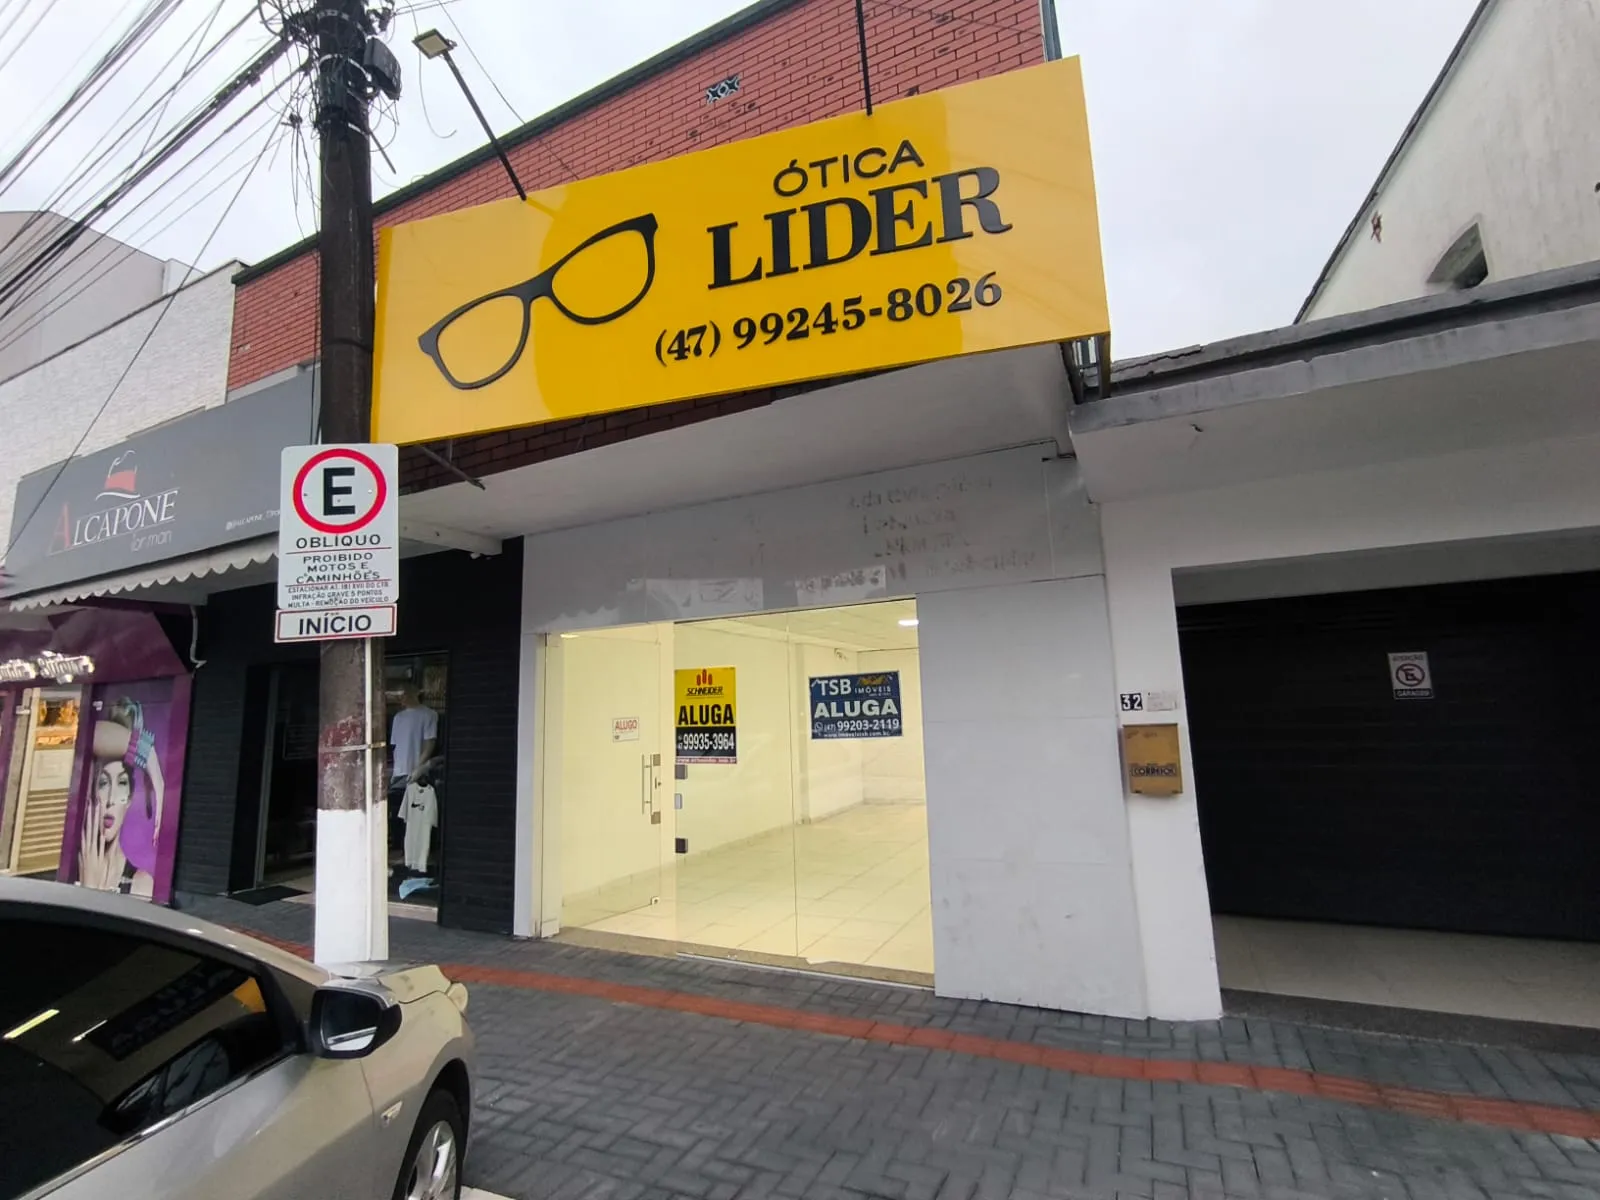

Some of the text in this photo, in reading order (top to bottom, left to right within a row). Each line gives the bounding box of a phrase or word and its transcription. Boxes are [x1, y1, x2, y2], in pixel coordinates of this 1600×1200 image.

[773, 139, 924, 197] ÓTICA
[707, 166, 1013, 290] LIDER
[655, 271, 1002, 366] (47) 99245-8026
[323, 467, 355, 516] E
[47, 490, 178, 556] ALCAPONE
[303, 552, 373, 565] PROIBIDO
[307, 561, 369, 573] MOTOS E
[296, 570, 380, 584] CAMINHÕES
[288, 584, 328, 594] ESTACIONAR
[366, 581, 375, 589] DO
[292, 591, 326, 601] INFRAÇÃO
[327, 590, 349, 599] GRAVE
[357, 589, 383, 597] PONTOS
[288, 601, 310, 609] MULTA
[299, 612, 372, 635] INÍCIO
[686, 686, 724, 695] SCHNEIDER
[816, 678, 852, 696] TSB
[814, 698, 899, 718] ALUGA
[1122, 694, 1142, 710] 32
[678, 703, 734, 725] ALUGA
[837, 718, 900, 732] 99203-2119
[683, 733, 735, 750] 99935-3964
